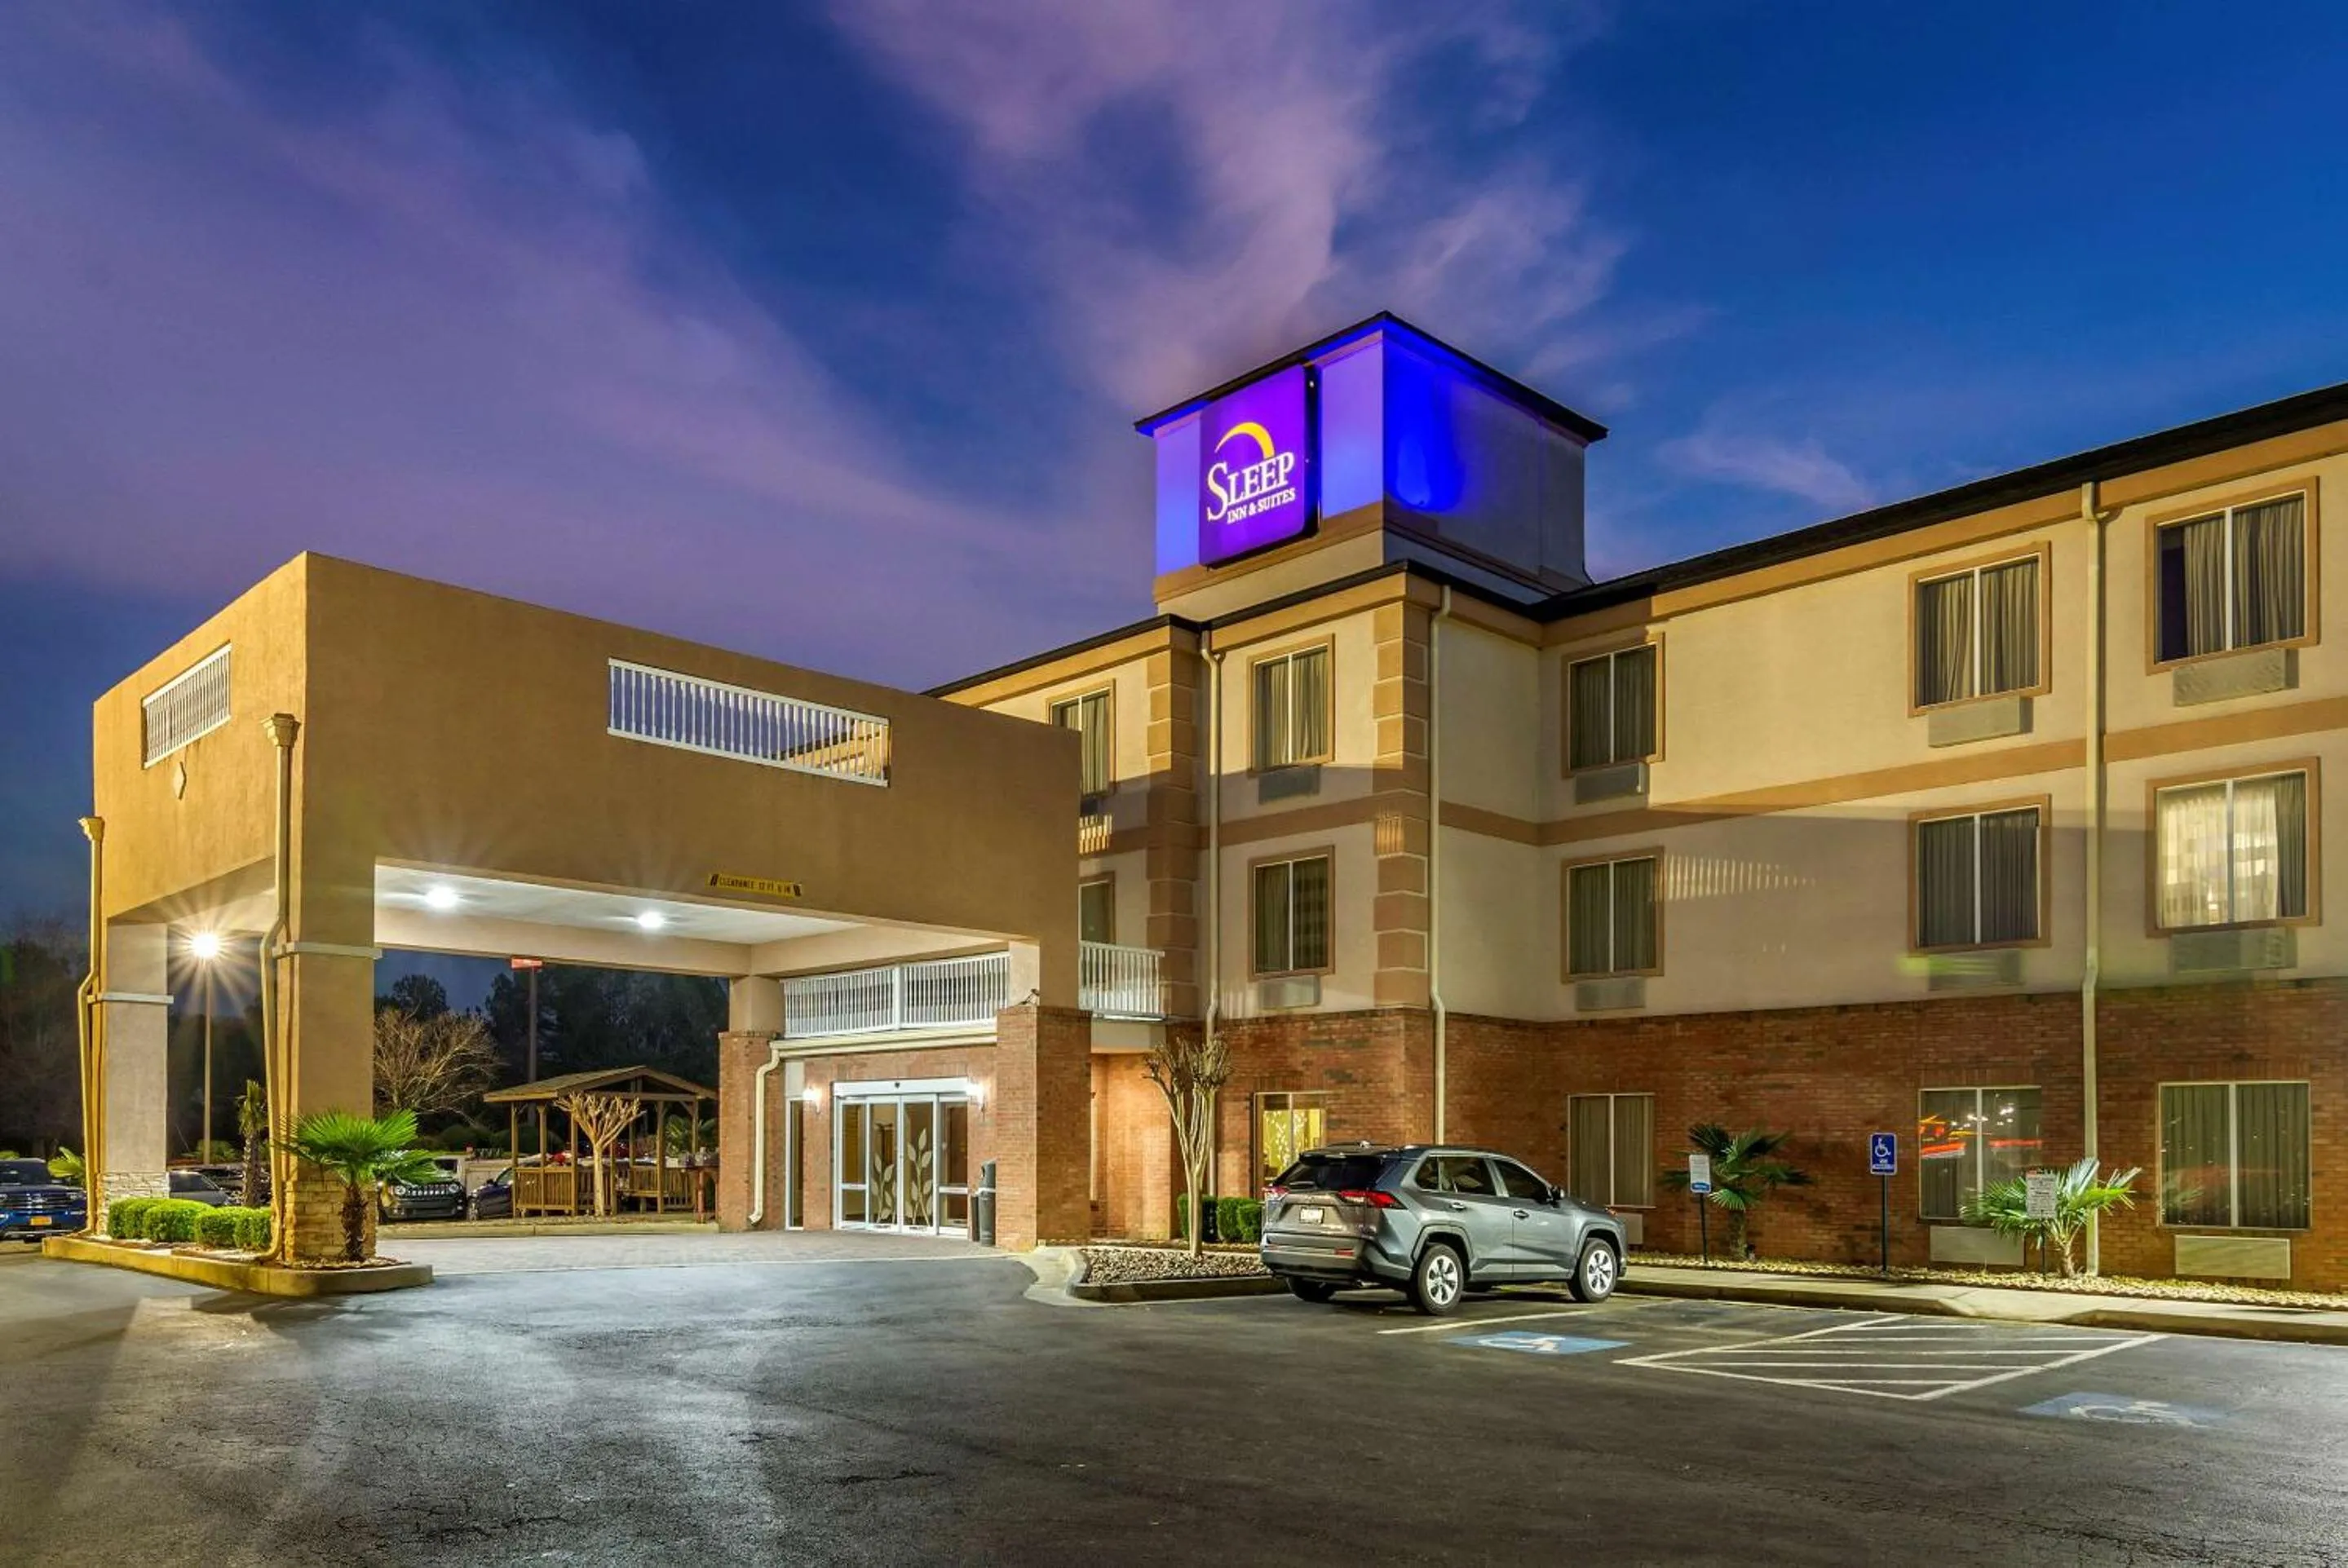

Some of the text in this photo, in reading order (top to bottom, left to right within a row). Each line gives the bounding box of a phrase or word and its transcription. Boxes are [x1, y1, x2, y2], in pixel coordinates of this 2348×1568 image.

[1207, 452, 1294, 521] SLEEP
[1227, 488, 1296, 524] INN & SUITES
